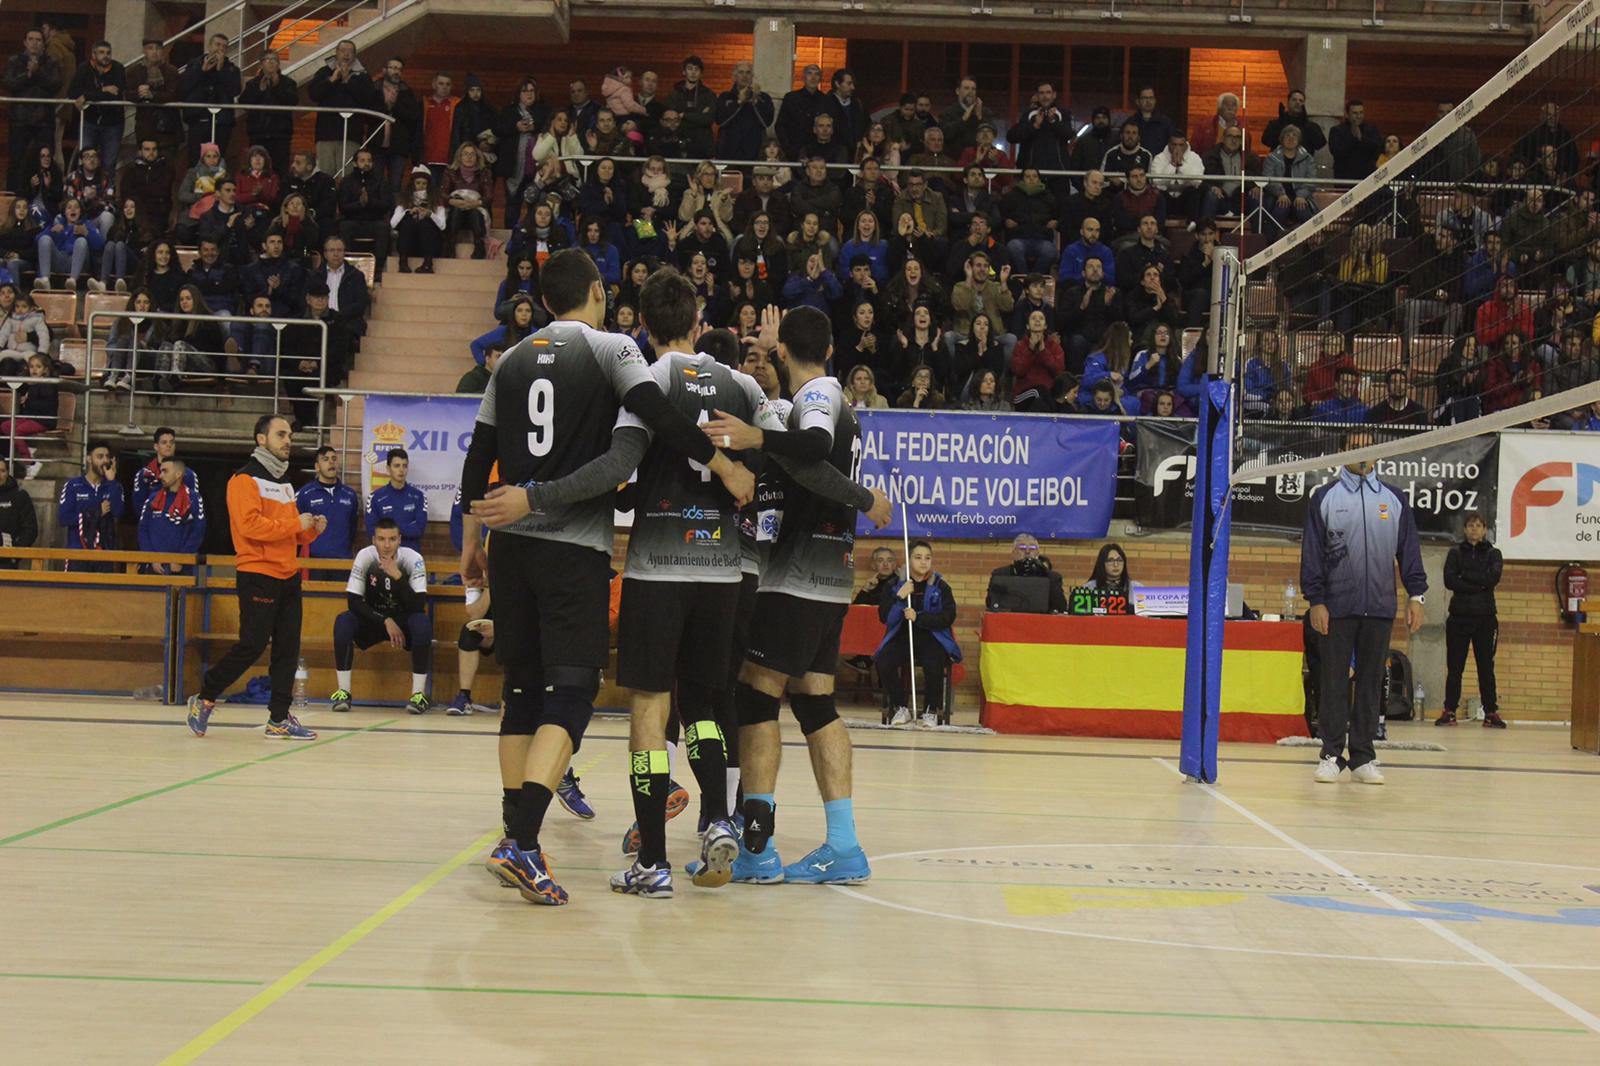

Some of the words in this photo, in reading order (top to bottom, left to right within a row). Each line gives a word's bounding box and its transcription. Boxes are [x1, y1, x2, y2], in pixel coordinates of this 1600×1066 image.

[528, 378, 554, 457] 9
[408, 430, 449, 451] XII
[863, 431, 891, 461] AL
[896, 427, 1030, 465] FEDERACIÓN
[863, 467, 946, 506] PAÑOLA
[951, 476, 979, 507] DE
[984, 476, 1089, 507] VOLEIBOL
[916, 511, 1017, 525] www.rfevb.com
[1575, 530, 1593, 542] de
[646, 552, 711, 569] Ayuntamiento
[384, 577, 391, 591] 8
[1073, 595, 1092, 613] 21
[1107, 596, 1127, 614] 22
